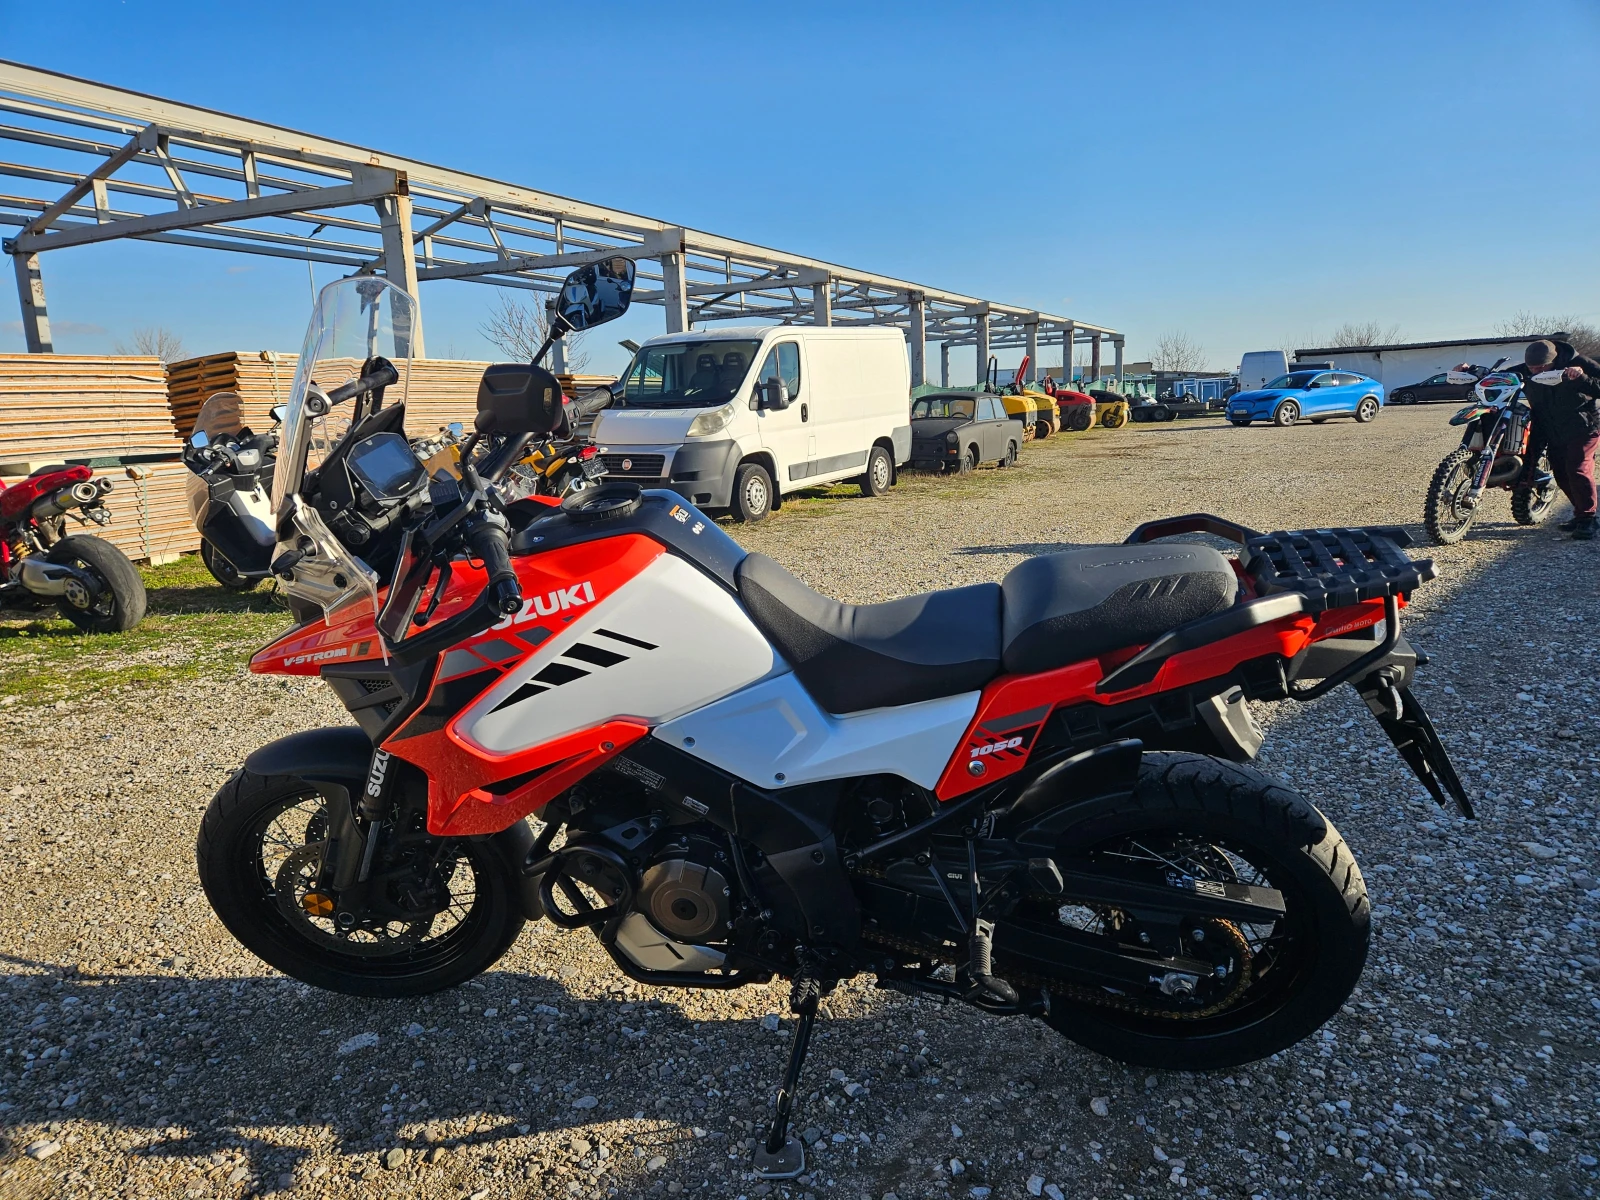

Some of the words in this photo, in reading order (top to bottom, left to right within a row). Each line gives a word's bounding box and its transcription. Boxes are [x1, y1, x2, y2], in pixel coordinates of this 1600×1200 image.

[470, 580, 597, 638] ZUKI
[283, 647, 348, 667] V-STROM
[970, 736, 1023, 758] 1050
[367, 751, 390, 798] SUZU
